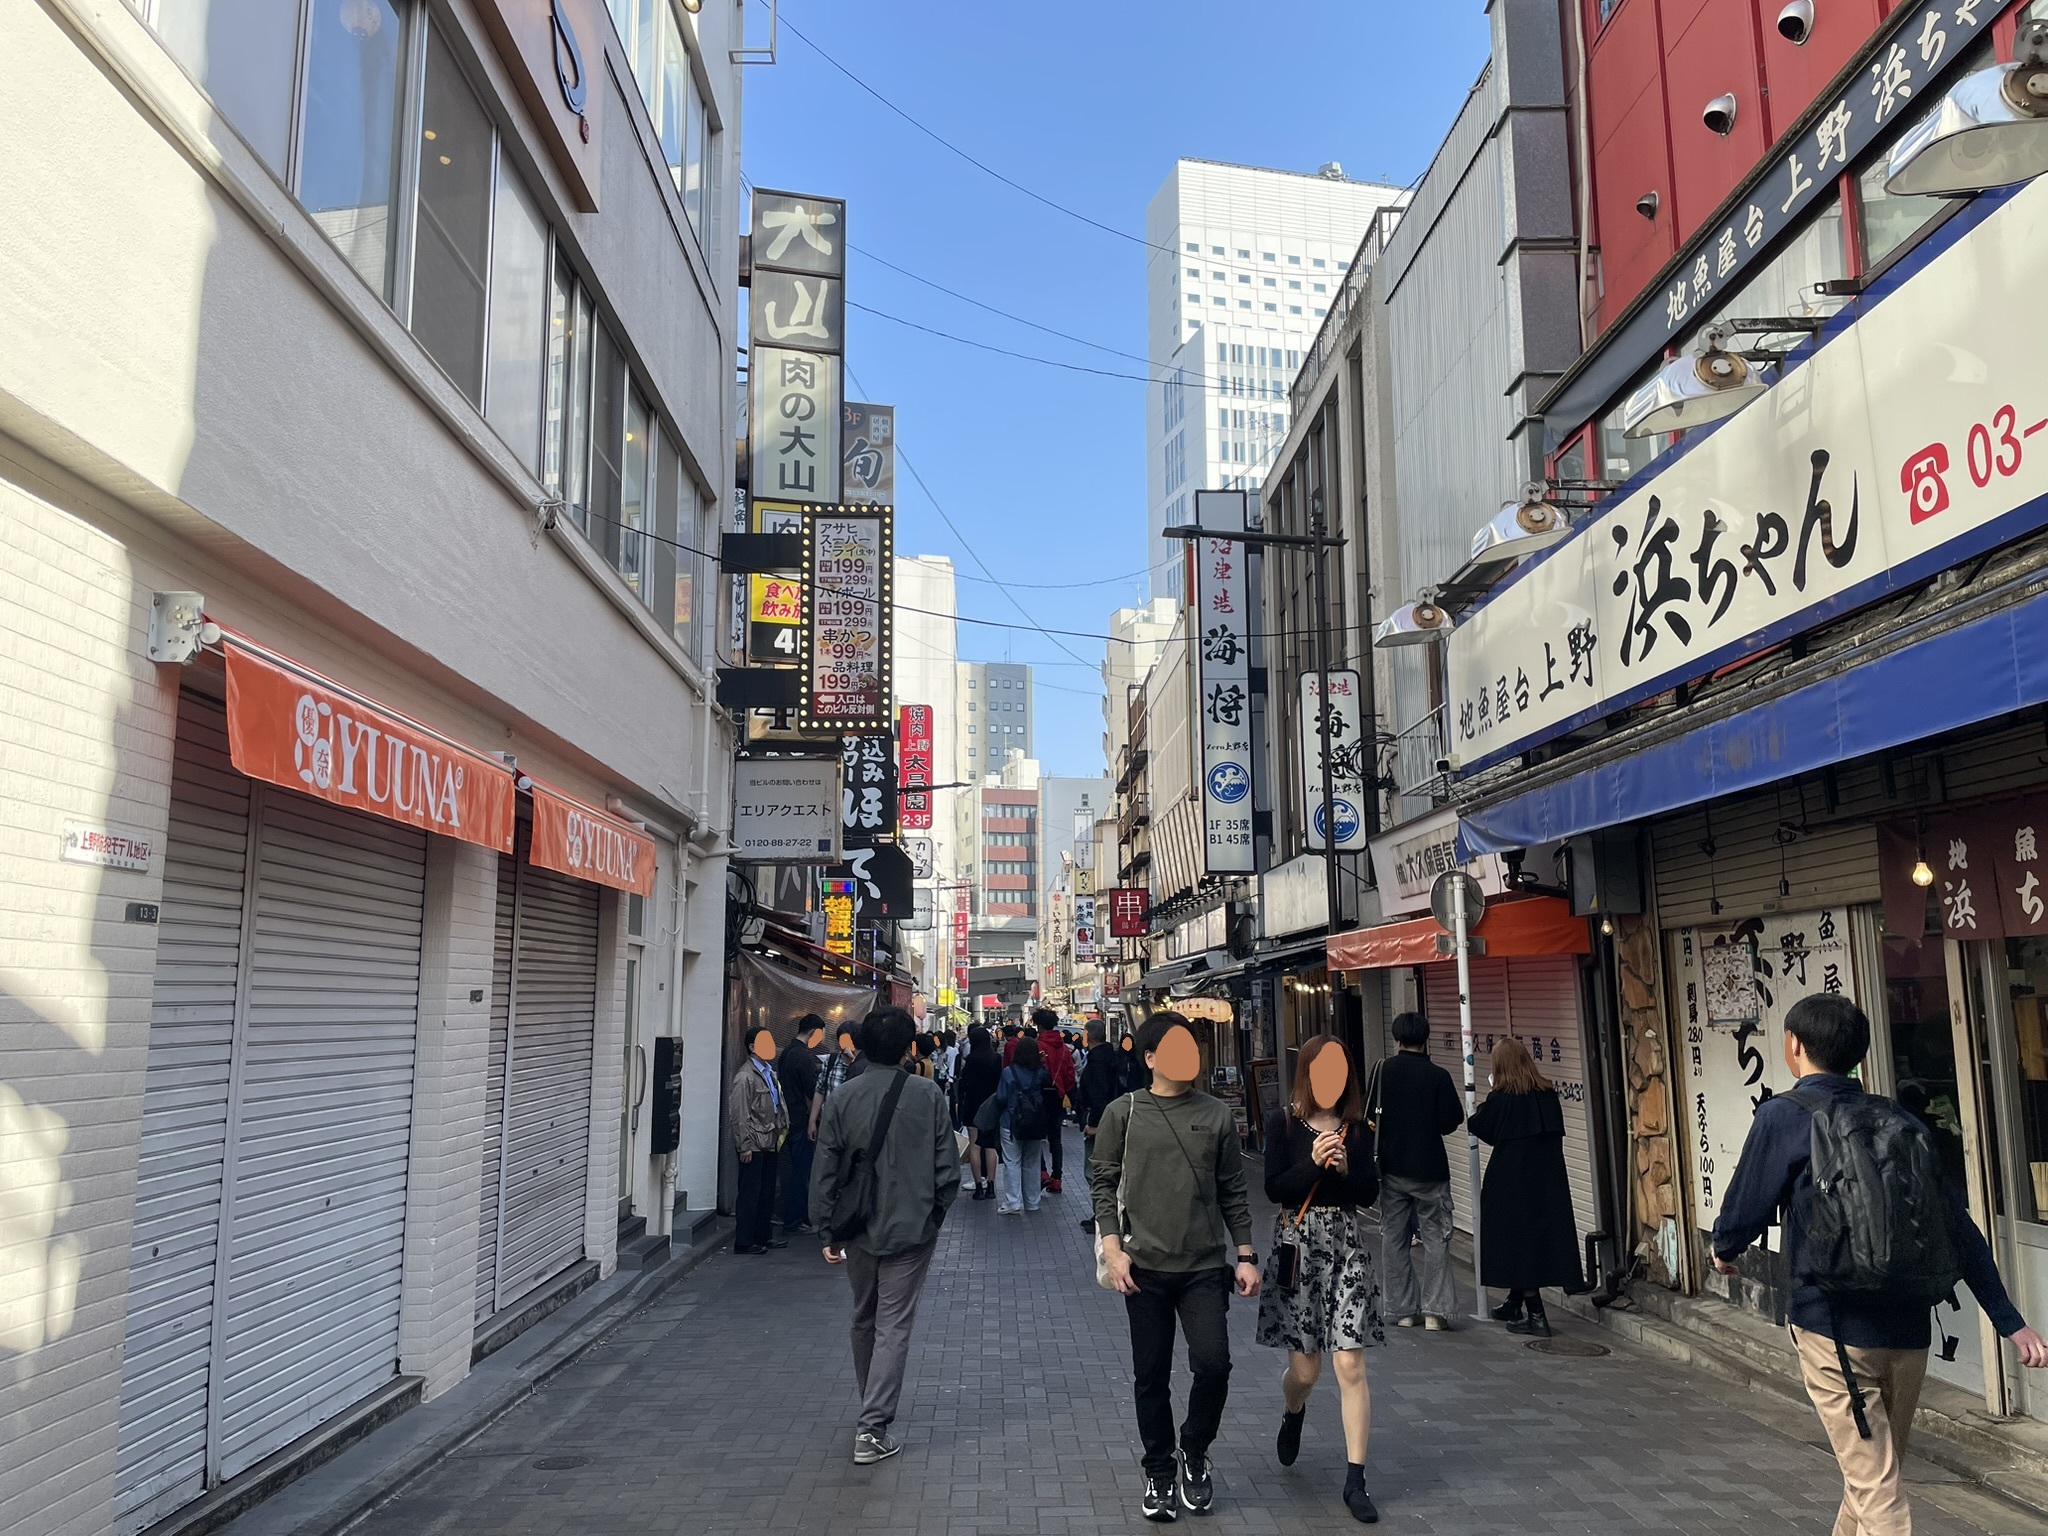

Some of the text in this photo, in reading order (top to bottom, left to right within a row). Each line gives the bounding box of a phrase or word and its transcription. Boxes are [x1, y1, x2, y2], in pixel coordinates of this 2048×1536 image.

[1781, 100, 1852, 213] 上野
[1871, 0, 2001, 123] 浜ちゃ
[762, 205, 836, 340] 大山
[779, 357, 816, 493] 肉の大山
[820, 523, 858, 534] アサヒ
[820, 534, 871, 545] スーパー
[820, 587, 876, 599] ハイボール
[1458, 448, 1858, 742] 地魚屋台 上野 浜ちゃん
[822, 628, 871, 644] 串かつ
[818, 661, 874, 673] 一品料理
[836, 694, 866, 704] 入口は
[817, 705, 875, 715] このビル反対側
[908, 708, 926, 737] 焼肉
[860, 735, 886, 783] 込み
[337, 714, 460, 828] YUUNA
[740, 804, 832, 817] エリアクエスト
[1209, 818, 1250, 831] 1F 35席
[80, 830, 149, 861] 上野防犯モデル地区
[744, 838, 812, 848] 0120-88-27-22
[1209, 833, 1250, 845] B1 45席
[583, 818, 636, 884] YUUNA
[1117, 891, 1142, 921] 串
